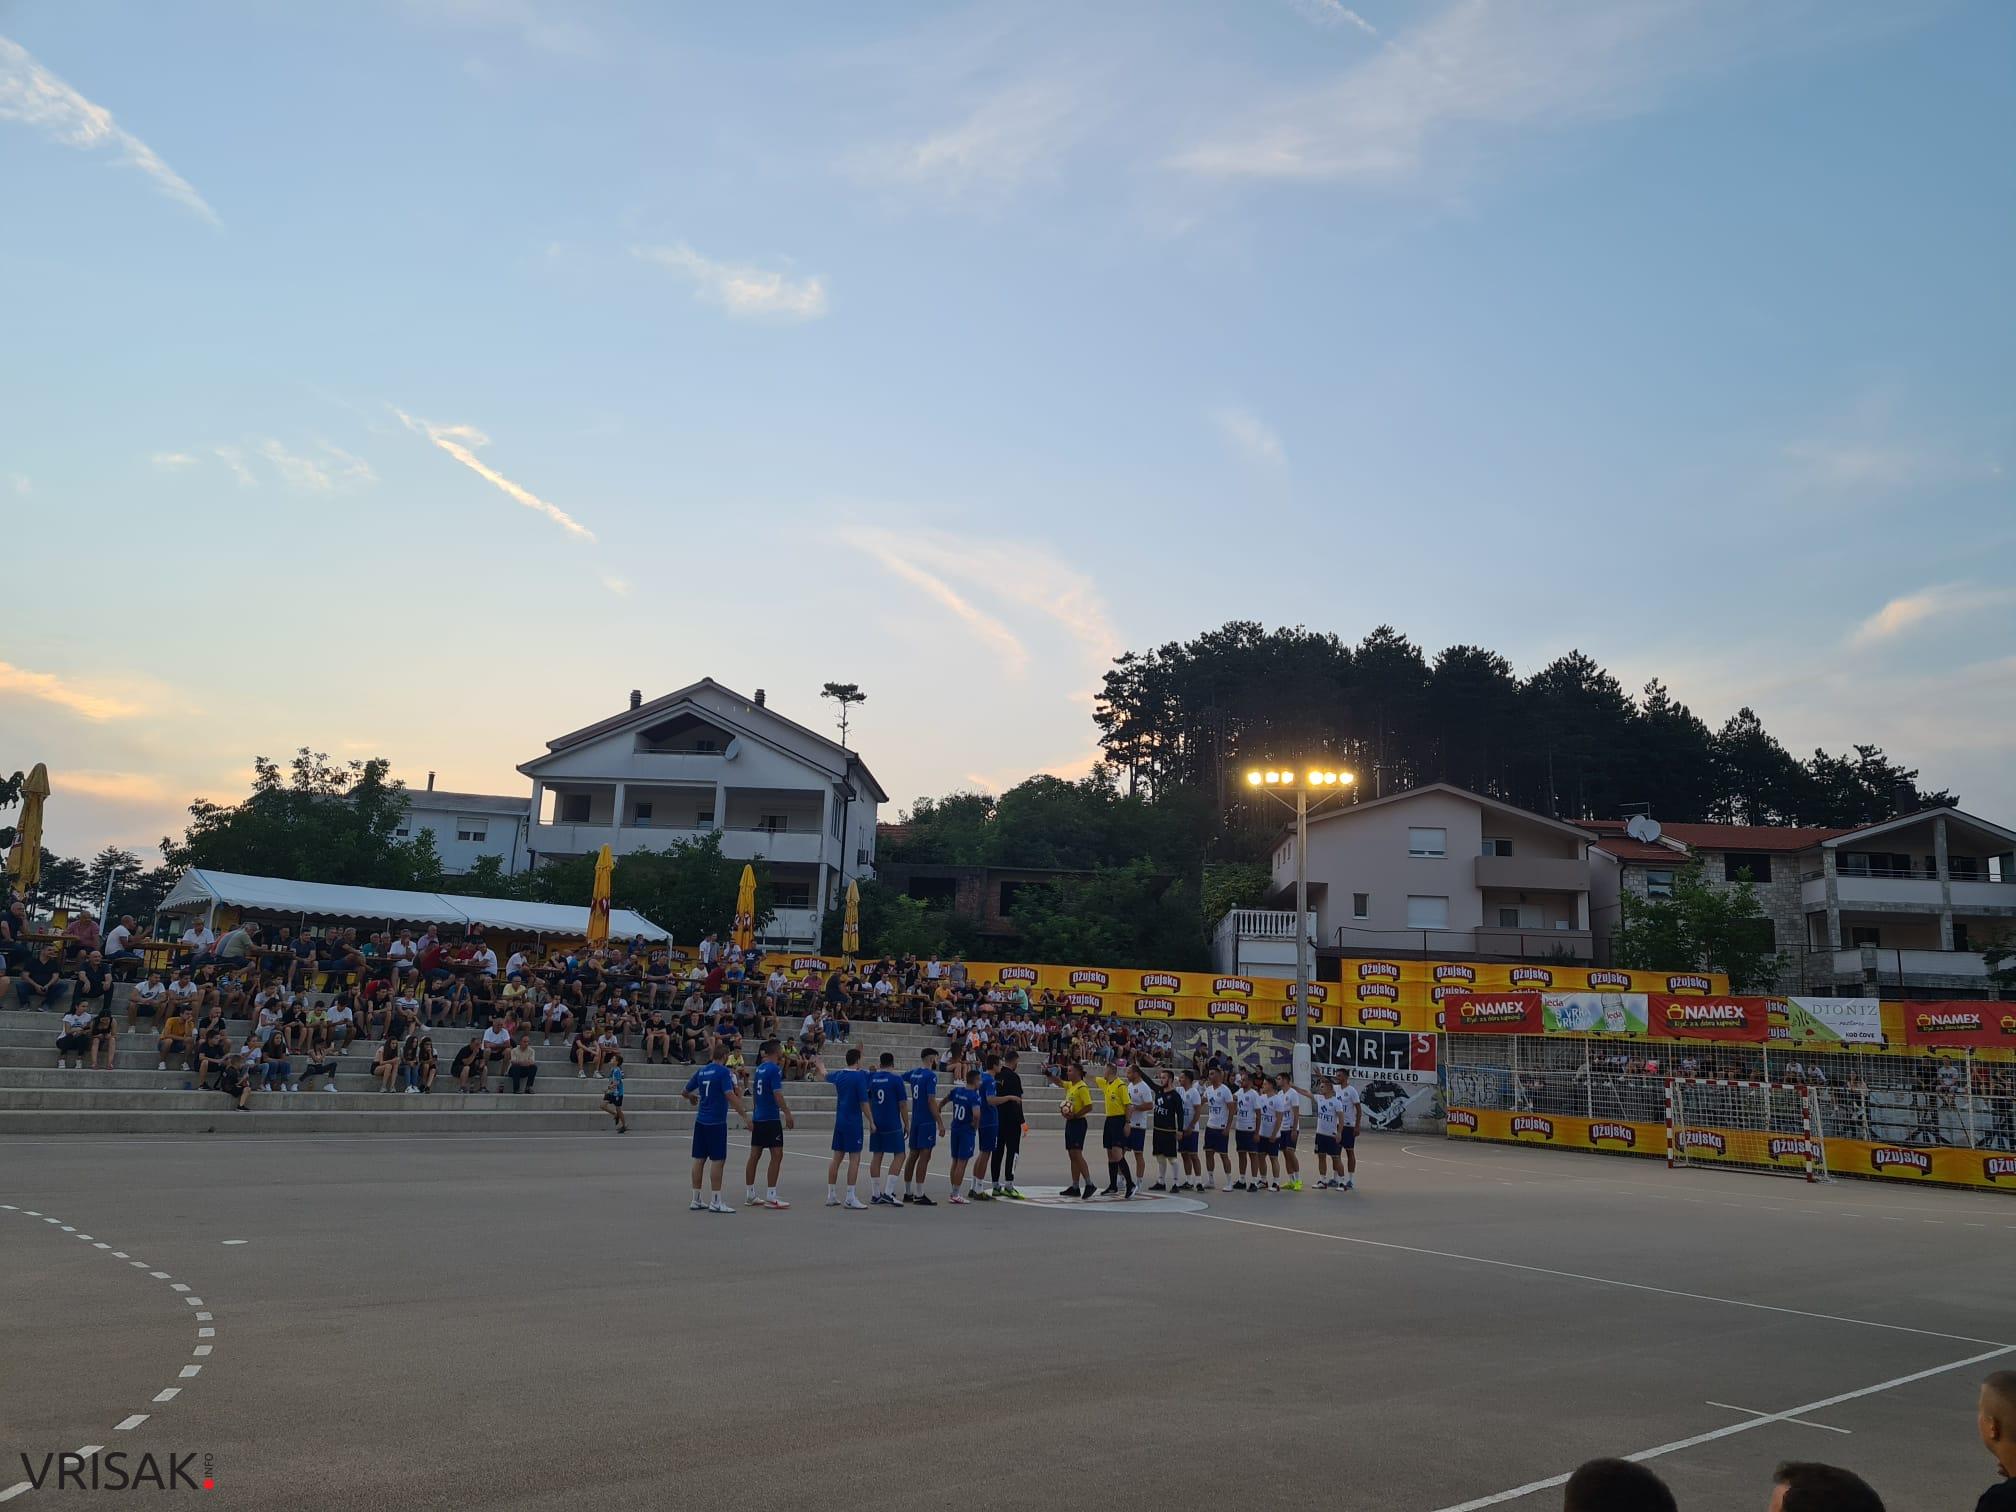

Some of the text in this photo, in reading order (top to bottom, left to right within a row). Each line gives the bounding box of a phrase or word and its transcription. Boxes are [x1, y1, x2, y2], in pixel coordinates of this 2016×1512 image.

[1002, 966, 1035, 980] Ožujsko
[1362, 963, 1397, 976] Ožujsko
[1437, 966, 1472, 979] Ožujsko
[1513, 968, 1549, 982] Ožujsko
[1073, 970, 1106, 984] Ožujsko
[1144, 974, 1178, 988] Ožujsko
[1590, 972, 1628, 985] Ožujsko
[1670, 976, 1708, 989] Ožujsko
[1216, 979, 1250, 992] Ožujsko
[1361, 983, 1396, 997] Ožujsko
[1138, 998, 1173, 1011] Ožujsko
[1211, 1001, 1245, 1014] Ožujsko
[1476, 1001, 1523, 1015] NAMEX
[1812, 1004, 1877, 1016] DIONIZ
[1362, 1008, 1397, 1020] Ožujsko
[1685, 1005, 1744, 1019] NAMEX
[1932, 1013, 1981, 1025] NAMEX
[1312, 1033, 1430, 1069] PARTS
[1374, 1071, 1419, 1082] PREGLED
[702, 1080, 711, 1097] 7
[756, 1079, 763, 1096] 5
[913, 1084, 919, 1100] 8
[877, 1089, 885, 1105] 9
[953, 1103, 966, 1121] 10
[1447, 1110, 1475, 1127] žujsko
[1514, 1116, 1550, 1133] Ožujsko
[1592, 1122, 1632, 1141] Ožujsko
[1876, 1149, 1927, 1167] Ožujsko
